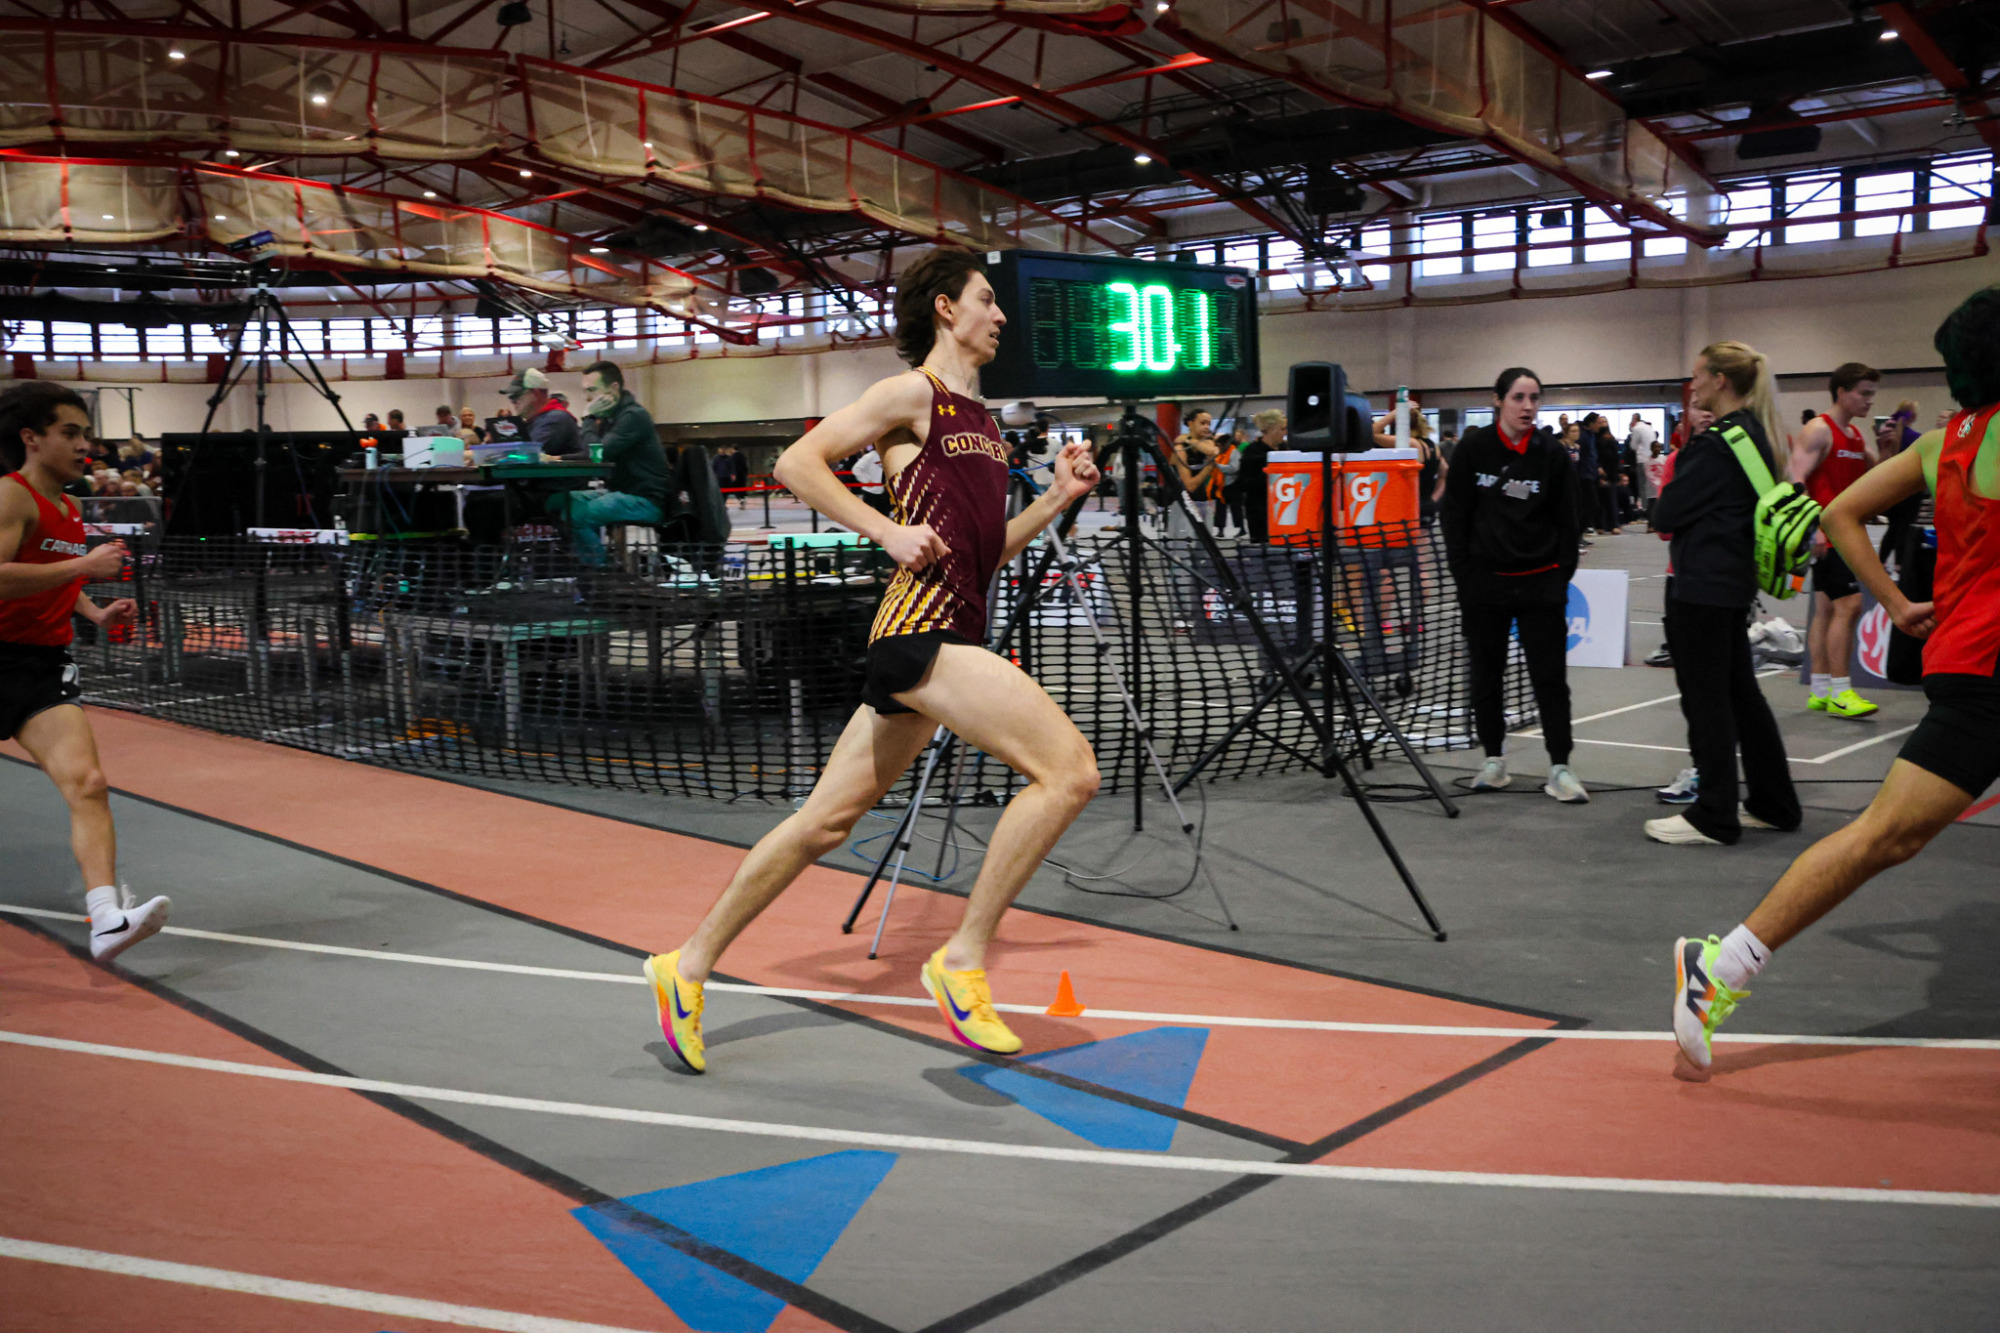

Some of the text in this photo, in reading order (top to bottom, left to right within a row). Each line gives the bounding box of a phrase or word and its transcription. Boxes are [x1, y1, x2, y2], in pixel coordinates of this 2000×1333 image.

[1106, 281, 1211, 371] 30.1
[1275, 476, 1296, 502] G
[1350, 475, 1372, 502] G
